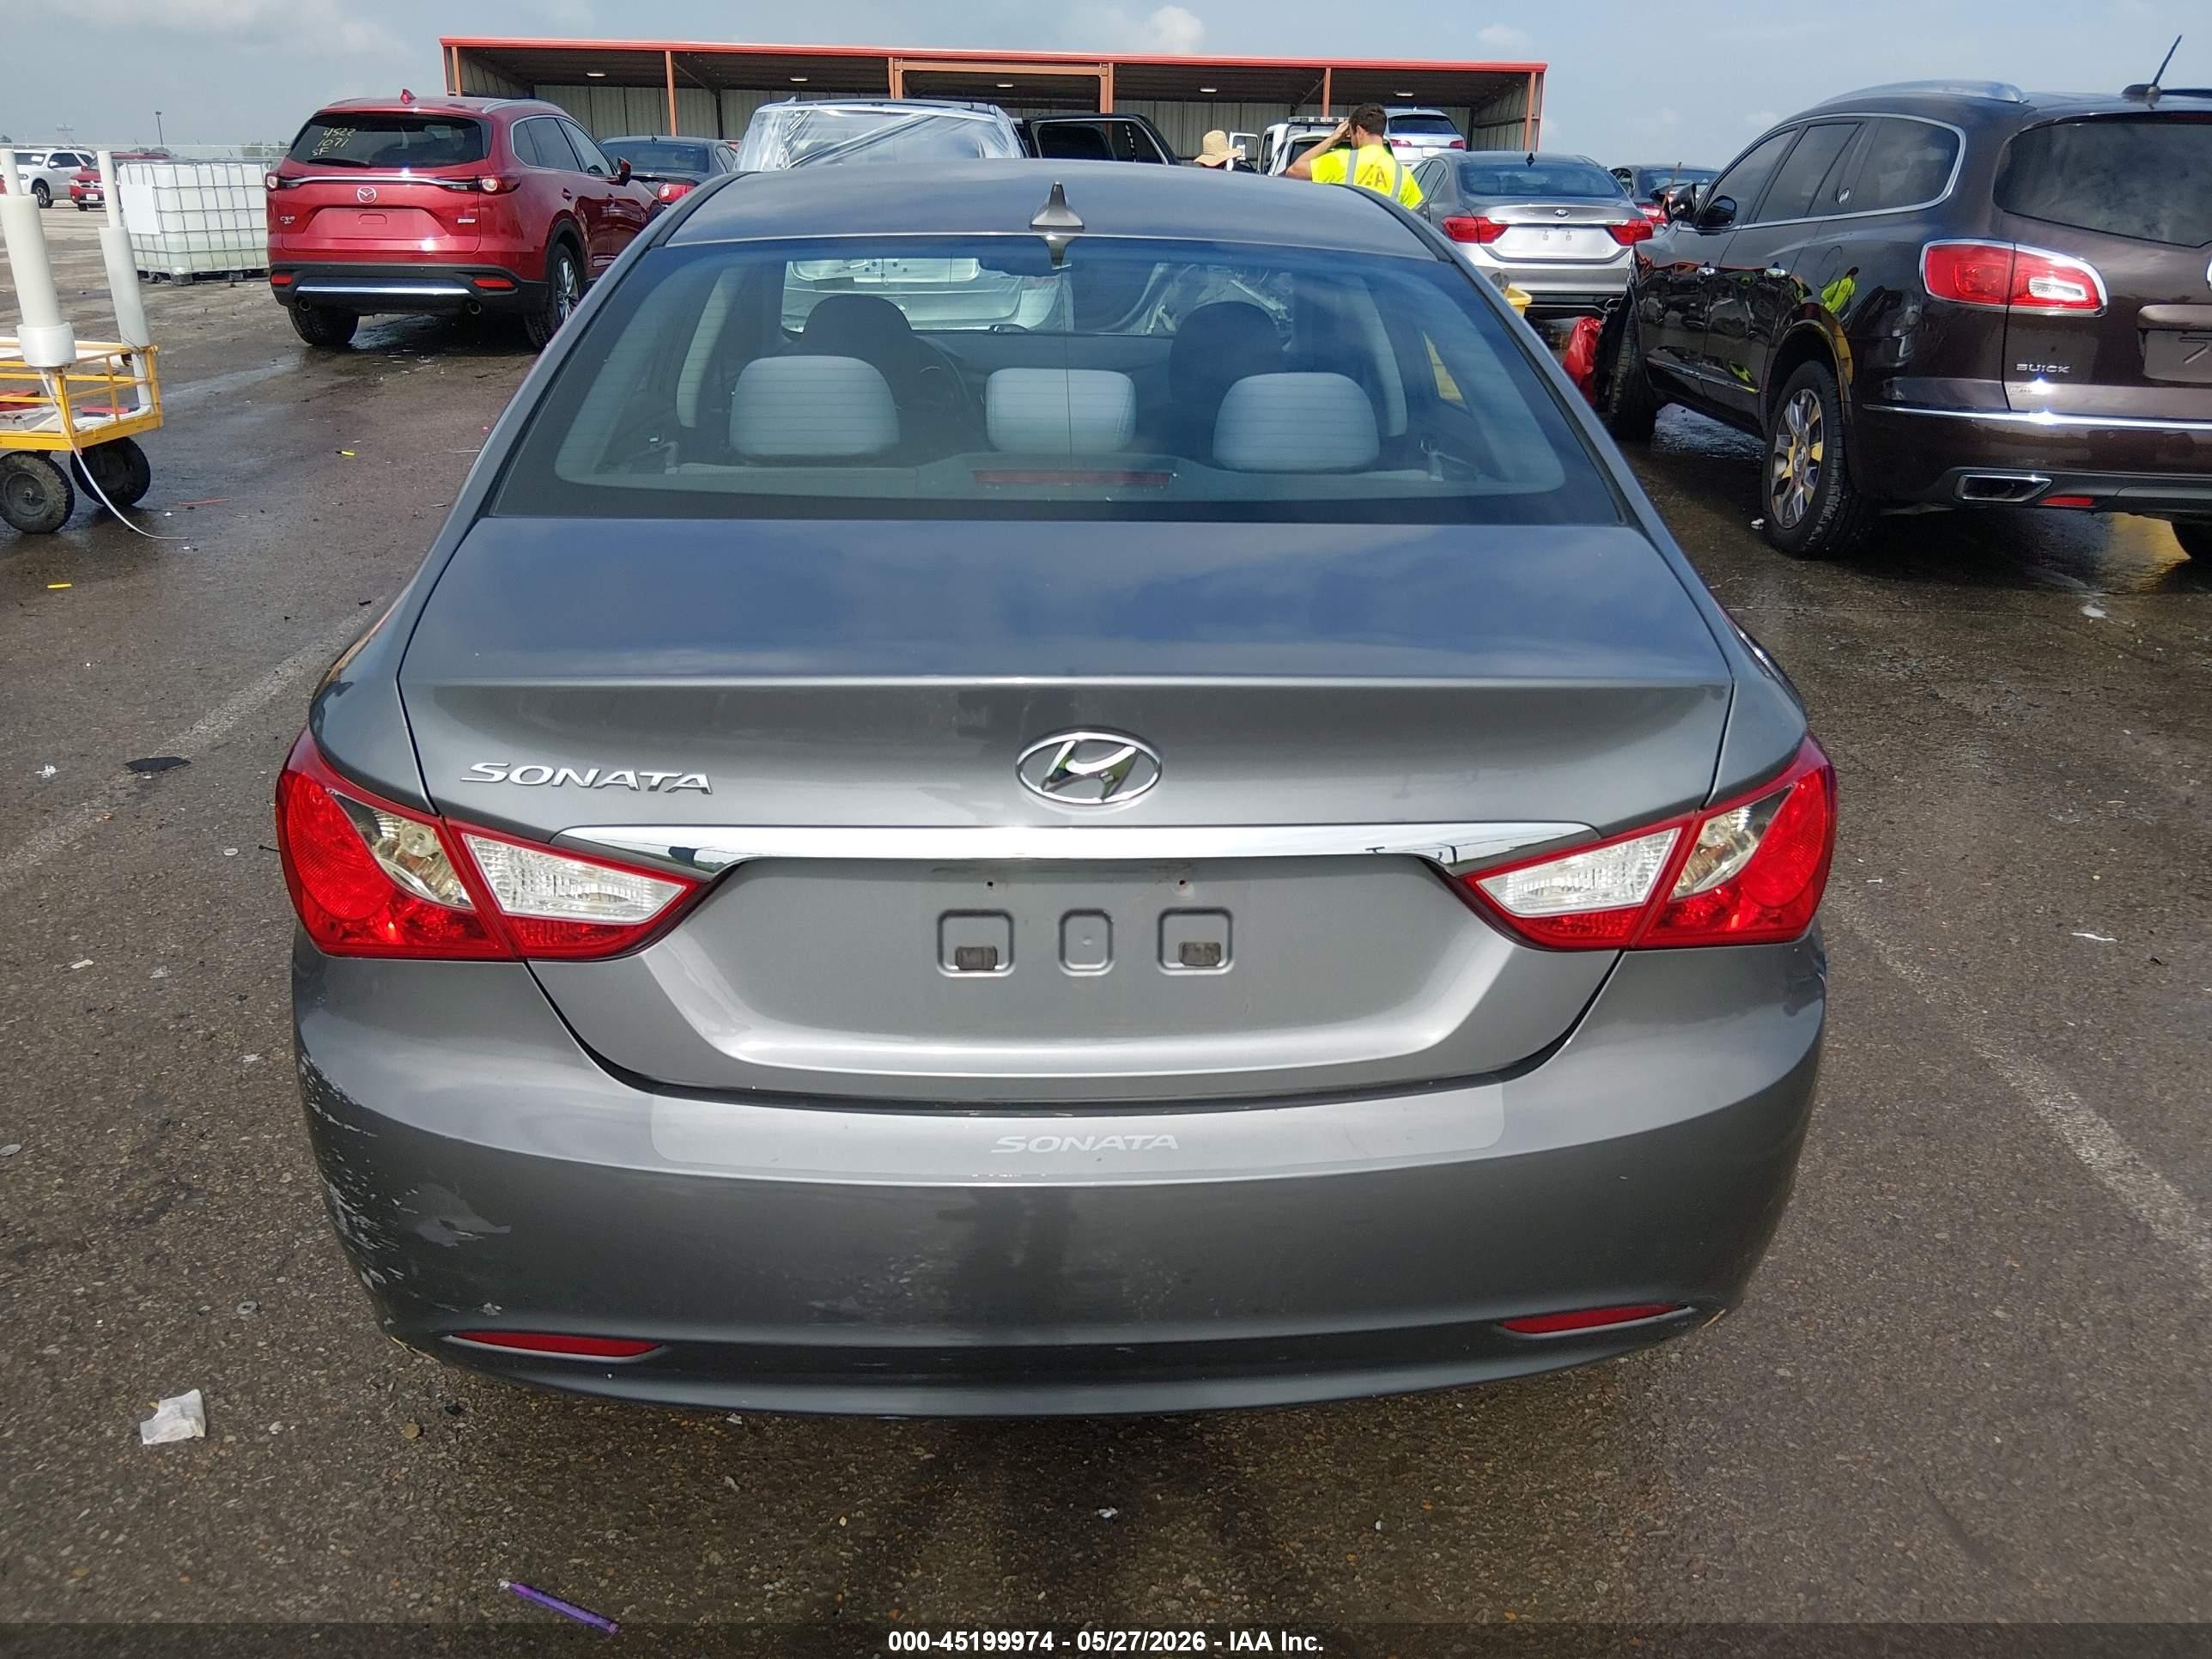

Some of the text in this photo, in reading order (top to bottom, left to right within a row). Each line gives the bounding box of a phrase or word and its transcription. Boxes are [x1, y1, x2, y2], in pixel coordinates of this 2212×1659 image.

[2015, 363, 2070, 374] BUICK
[460, 763, 713, 795] SONATA
[990, 1134, 1179, 1154] SONATA
